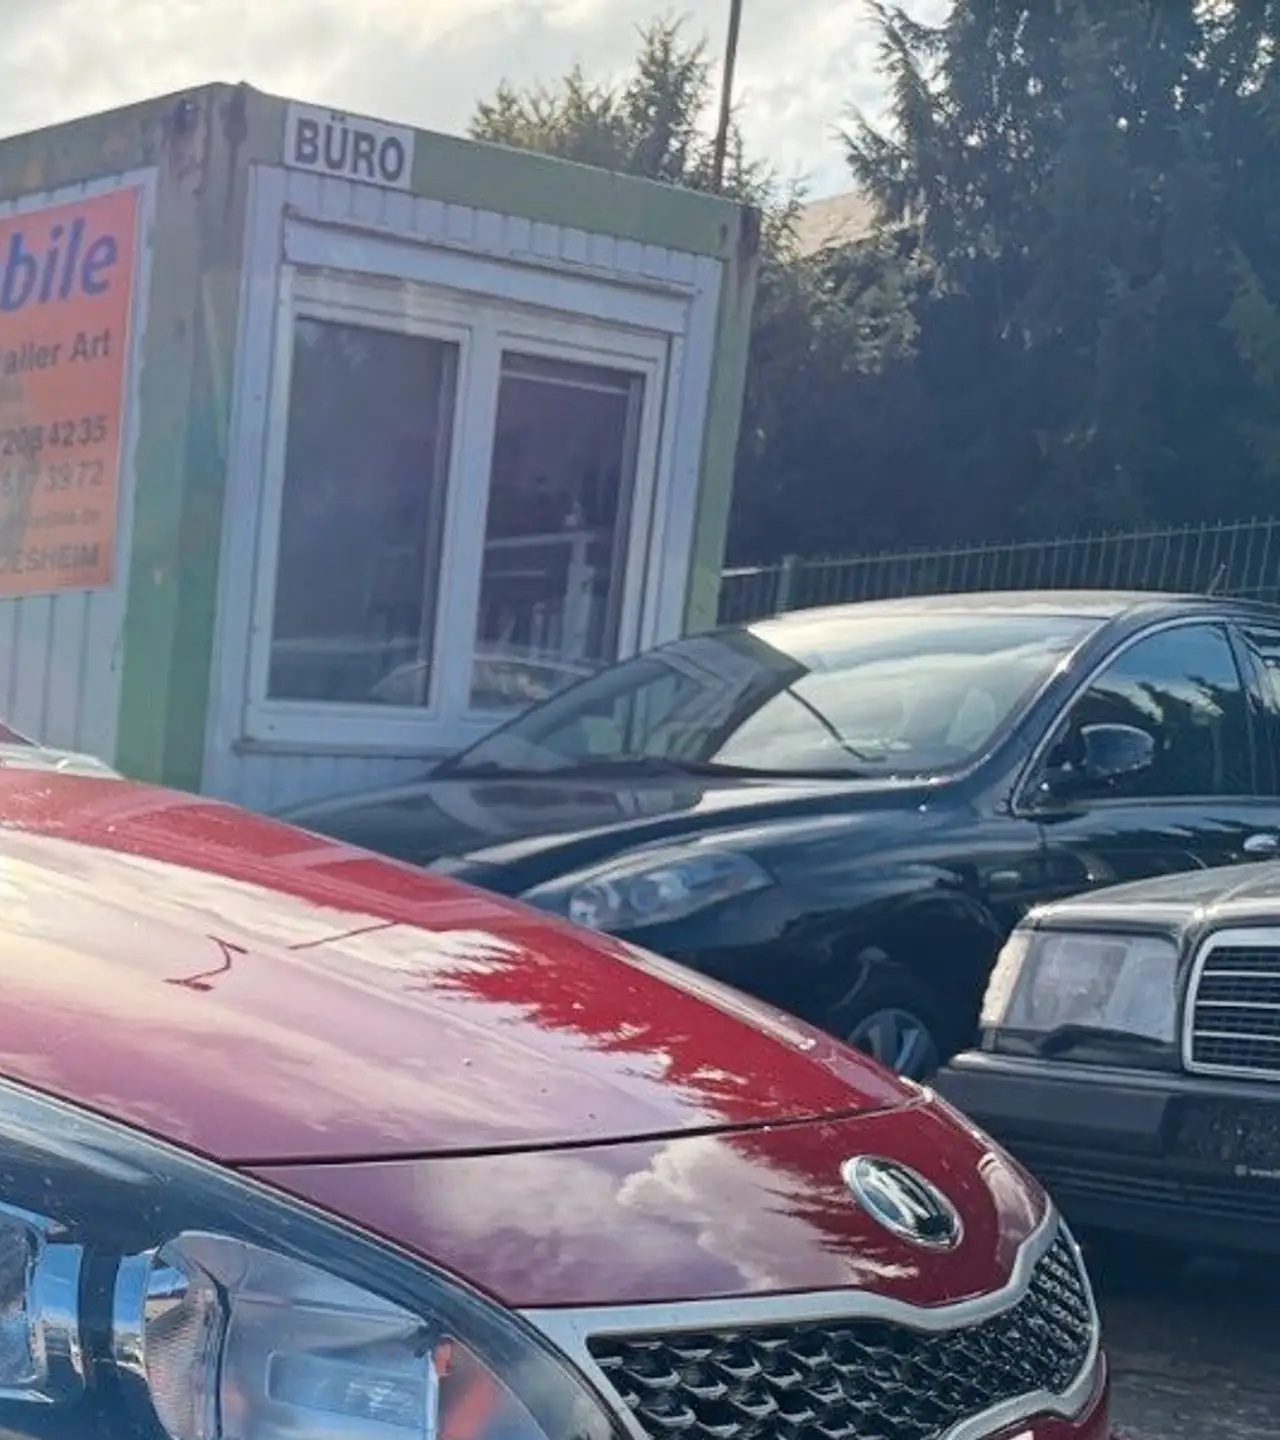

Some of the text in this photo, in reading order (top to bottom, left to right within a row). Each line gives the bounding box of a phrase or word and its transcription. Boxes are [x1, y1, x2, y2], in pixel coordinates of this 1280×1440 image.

[295, 114, 405, 182] BÜRO
[4, 343, 61, 374] aller
[70, 329, 111, 362] Art
[46, 413, 108, 448] 4235
